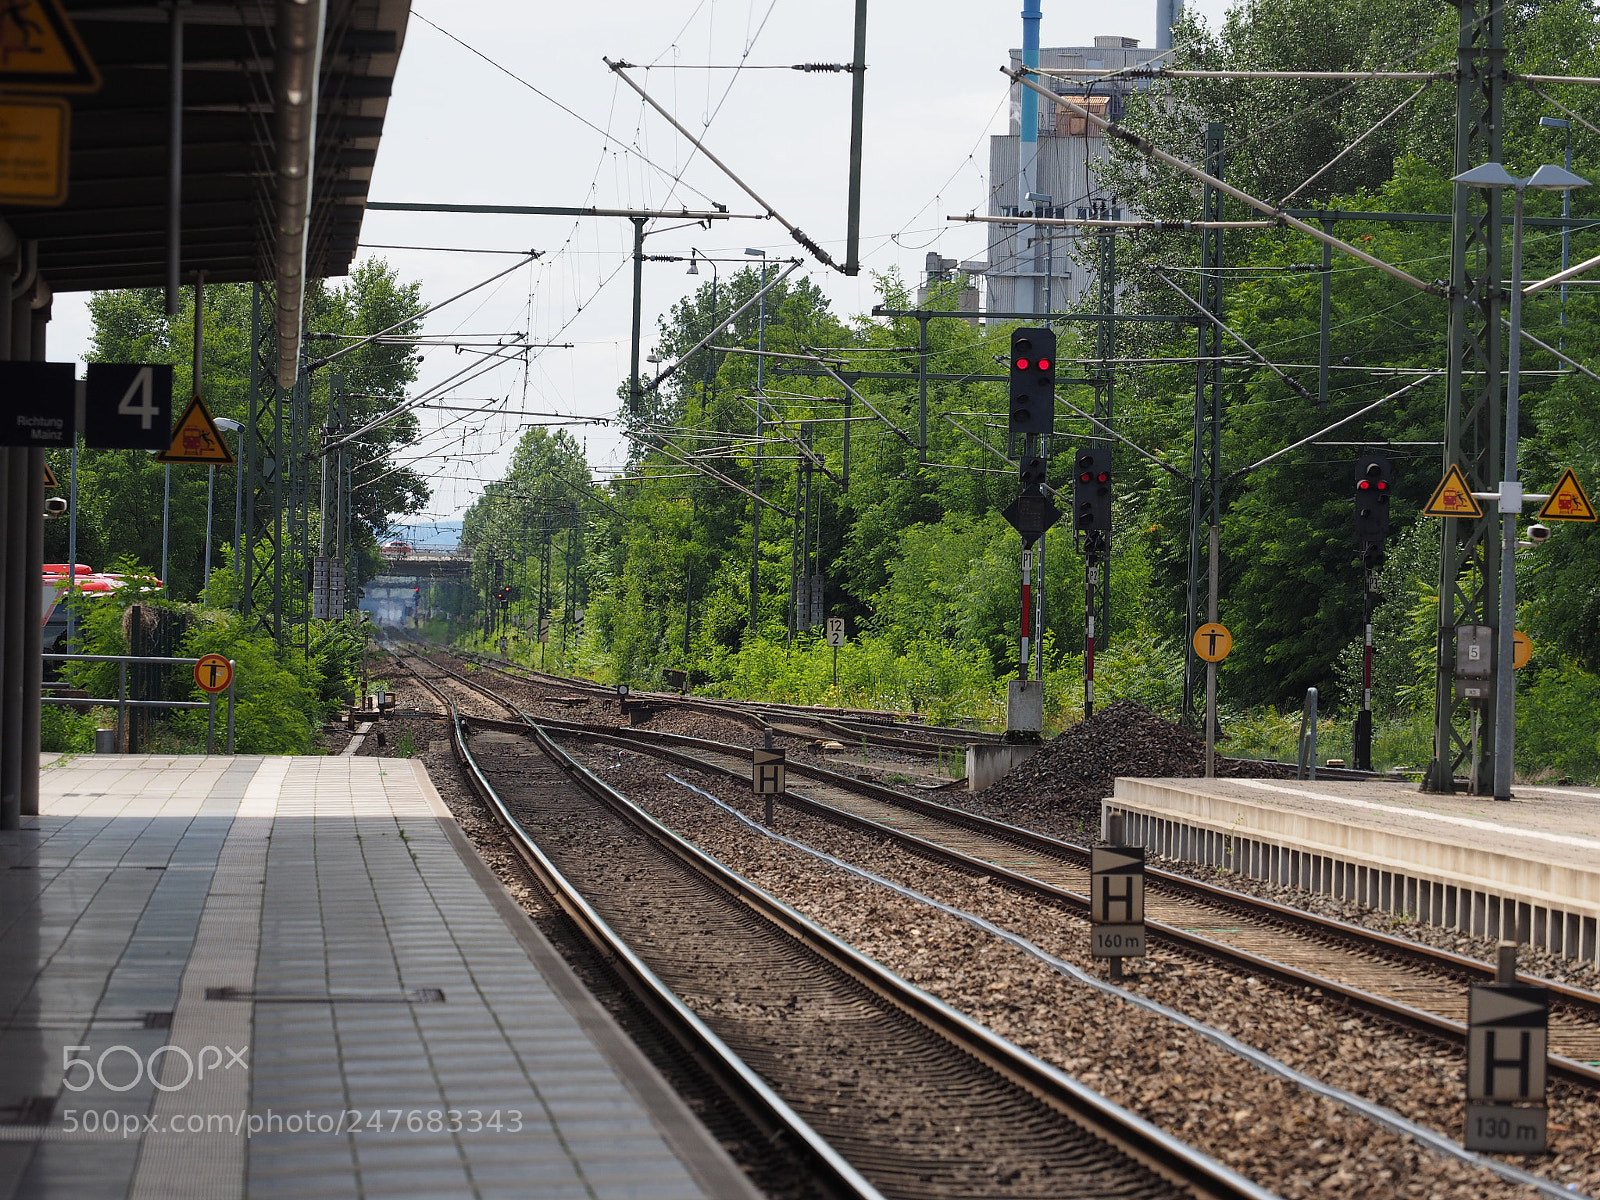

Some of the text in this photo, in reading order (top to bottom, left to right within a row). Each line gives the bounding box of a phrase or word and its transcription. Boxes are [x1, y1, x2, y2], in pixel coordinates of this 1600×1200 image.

[118, 367, 160, 430] 4
[16, 415, 63, 429] Richtung
[31, 429, 63, 440] Mainz
[1024, 553, 1032, 568] P1
[1089, 570, 1098, 581] P2
[1370, 577, 1378, 590] P3
[830, 620, 842, 631] 12
[832, 633, 839, 644] 2
[1471, 647, 1478, 658] 5
[760, 766, 778, 792] H
[1103, 876, 1133, 921] H
[1098, 934, 1139, 948] 160 m
[1484, 1031, 1530, 1097] H
[1477, 1117, 1537, 1141] 130 m
